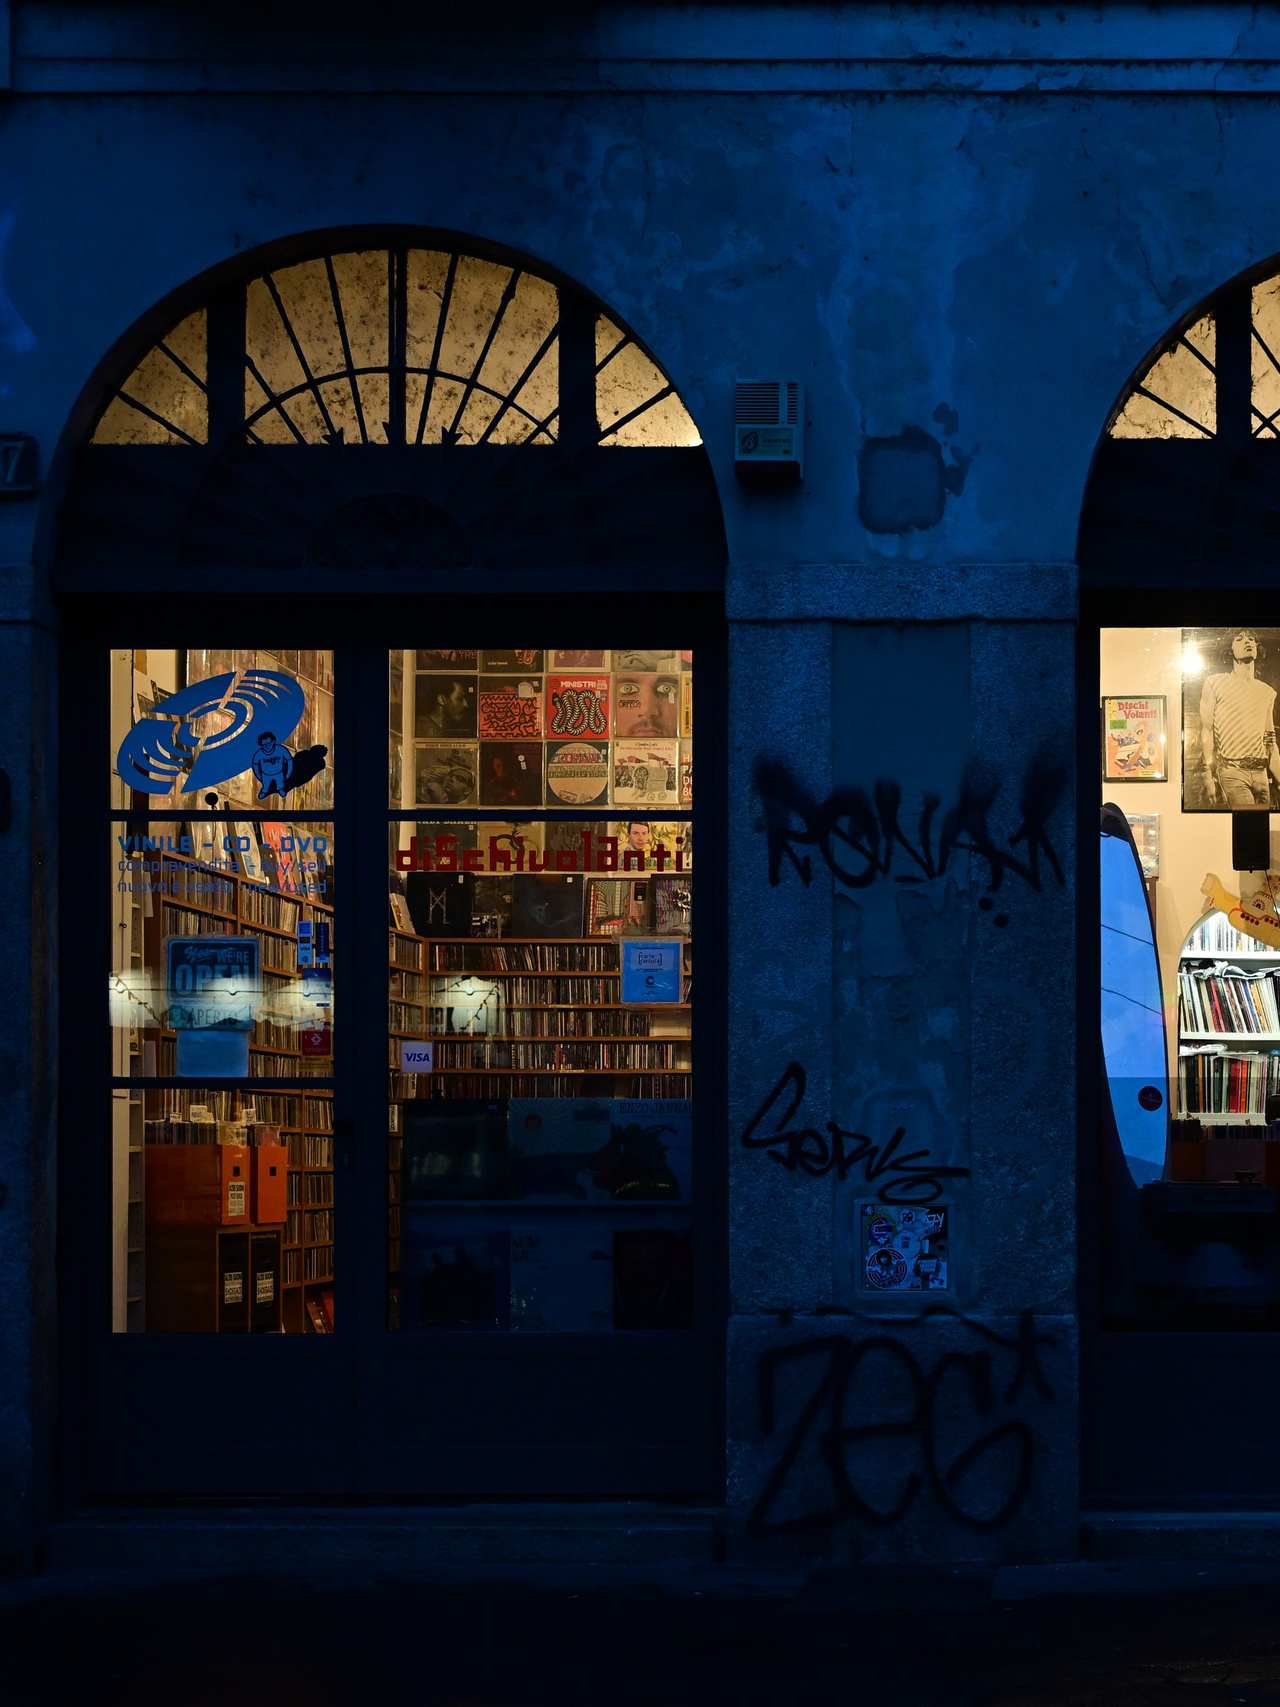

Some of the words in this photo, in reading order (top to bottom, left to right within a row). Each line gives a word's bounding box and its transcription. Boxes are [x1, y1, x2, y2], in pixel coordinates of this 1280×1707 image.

[1118, 701, 1149, 711] Dischi
[117, 835, 193, 852] VINILE
[223, 835, 250, 852] CD
[281, 835, 328, 852] DVD
[117, 857, 240, 876] compravendita
[260, 857, 328, 876] buy/sell
[117, 881, 167, 893] nuovo
[171, 882, 181, 893] e
[185, 880, 231, 893] usato
[247, 879, 328, 894] new/used
[217, 950, 249, 963] WE'RE
[186, 1008, 238, 1026] APERTO
[404, 1052, 430, 1062] VISA
[619, 1102, 649, 1113] ENZO
